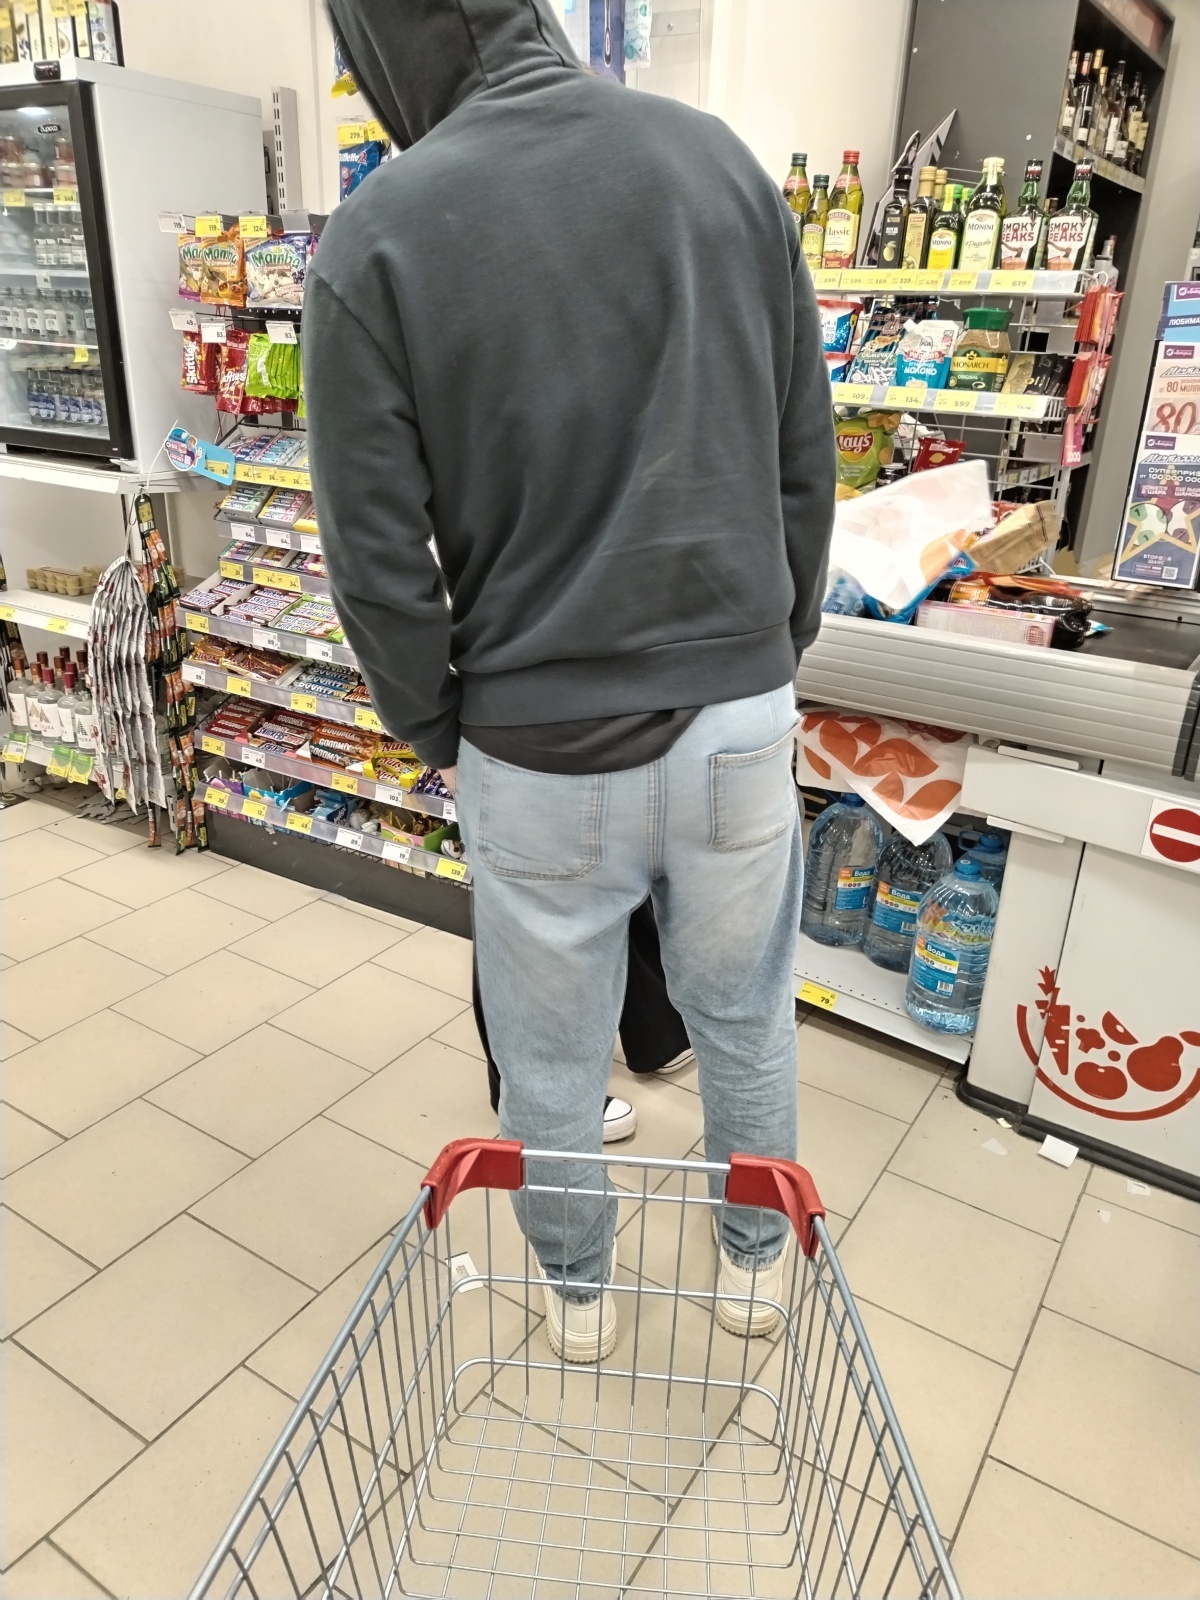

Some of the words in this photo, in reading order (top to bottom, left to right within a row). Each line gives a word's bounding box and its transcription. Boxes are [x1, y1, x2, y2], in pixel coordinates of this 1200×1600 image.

[967, 223, 995, 231] MONINI
[1002, 222, 1037, 232] SMOKY
[1049, 222, 1087, 232] SMOKY
[1001, 231, 1035, 242] PEAKS
[1048, 231, 1084, 242] PEAKS
[203, 246, 239, 264] Mamba
[250, 249, 302, 268] Mamba
[184, 340, 198, 384] Skittles
[953, 361, 989, 369] MONARCH
[904, 366, 938, 376] МОЛОКО
[1166, 381, 1179, 393] 80
[1152, 401, 1197, 434] 80
[839, 432, 872, 453] Lay's
[298, 681, 333, 695] BOUNTY
[318, 737, 353, 752] GOODMIX
[382, 741, 411, 752] Nuts
[310, 745, 342, 762] GOODMIX
[380, 757, 404, 771] Nuts
[891, 889, 911, 900] Вода
[926, 943, 946, 959] Вода
[820, 996, 830, 1005] 79
